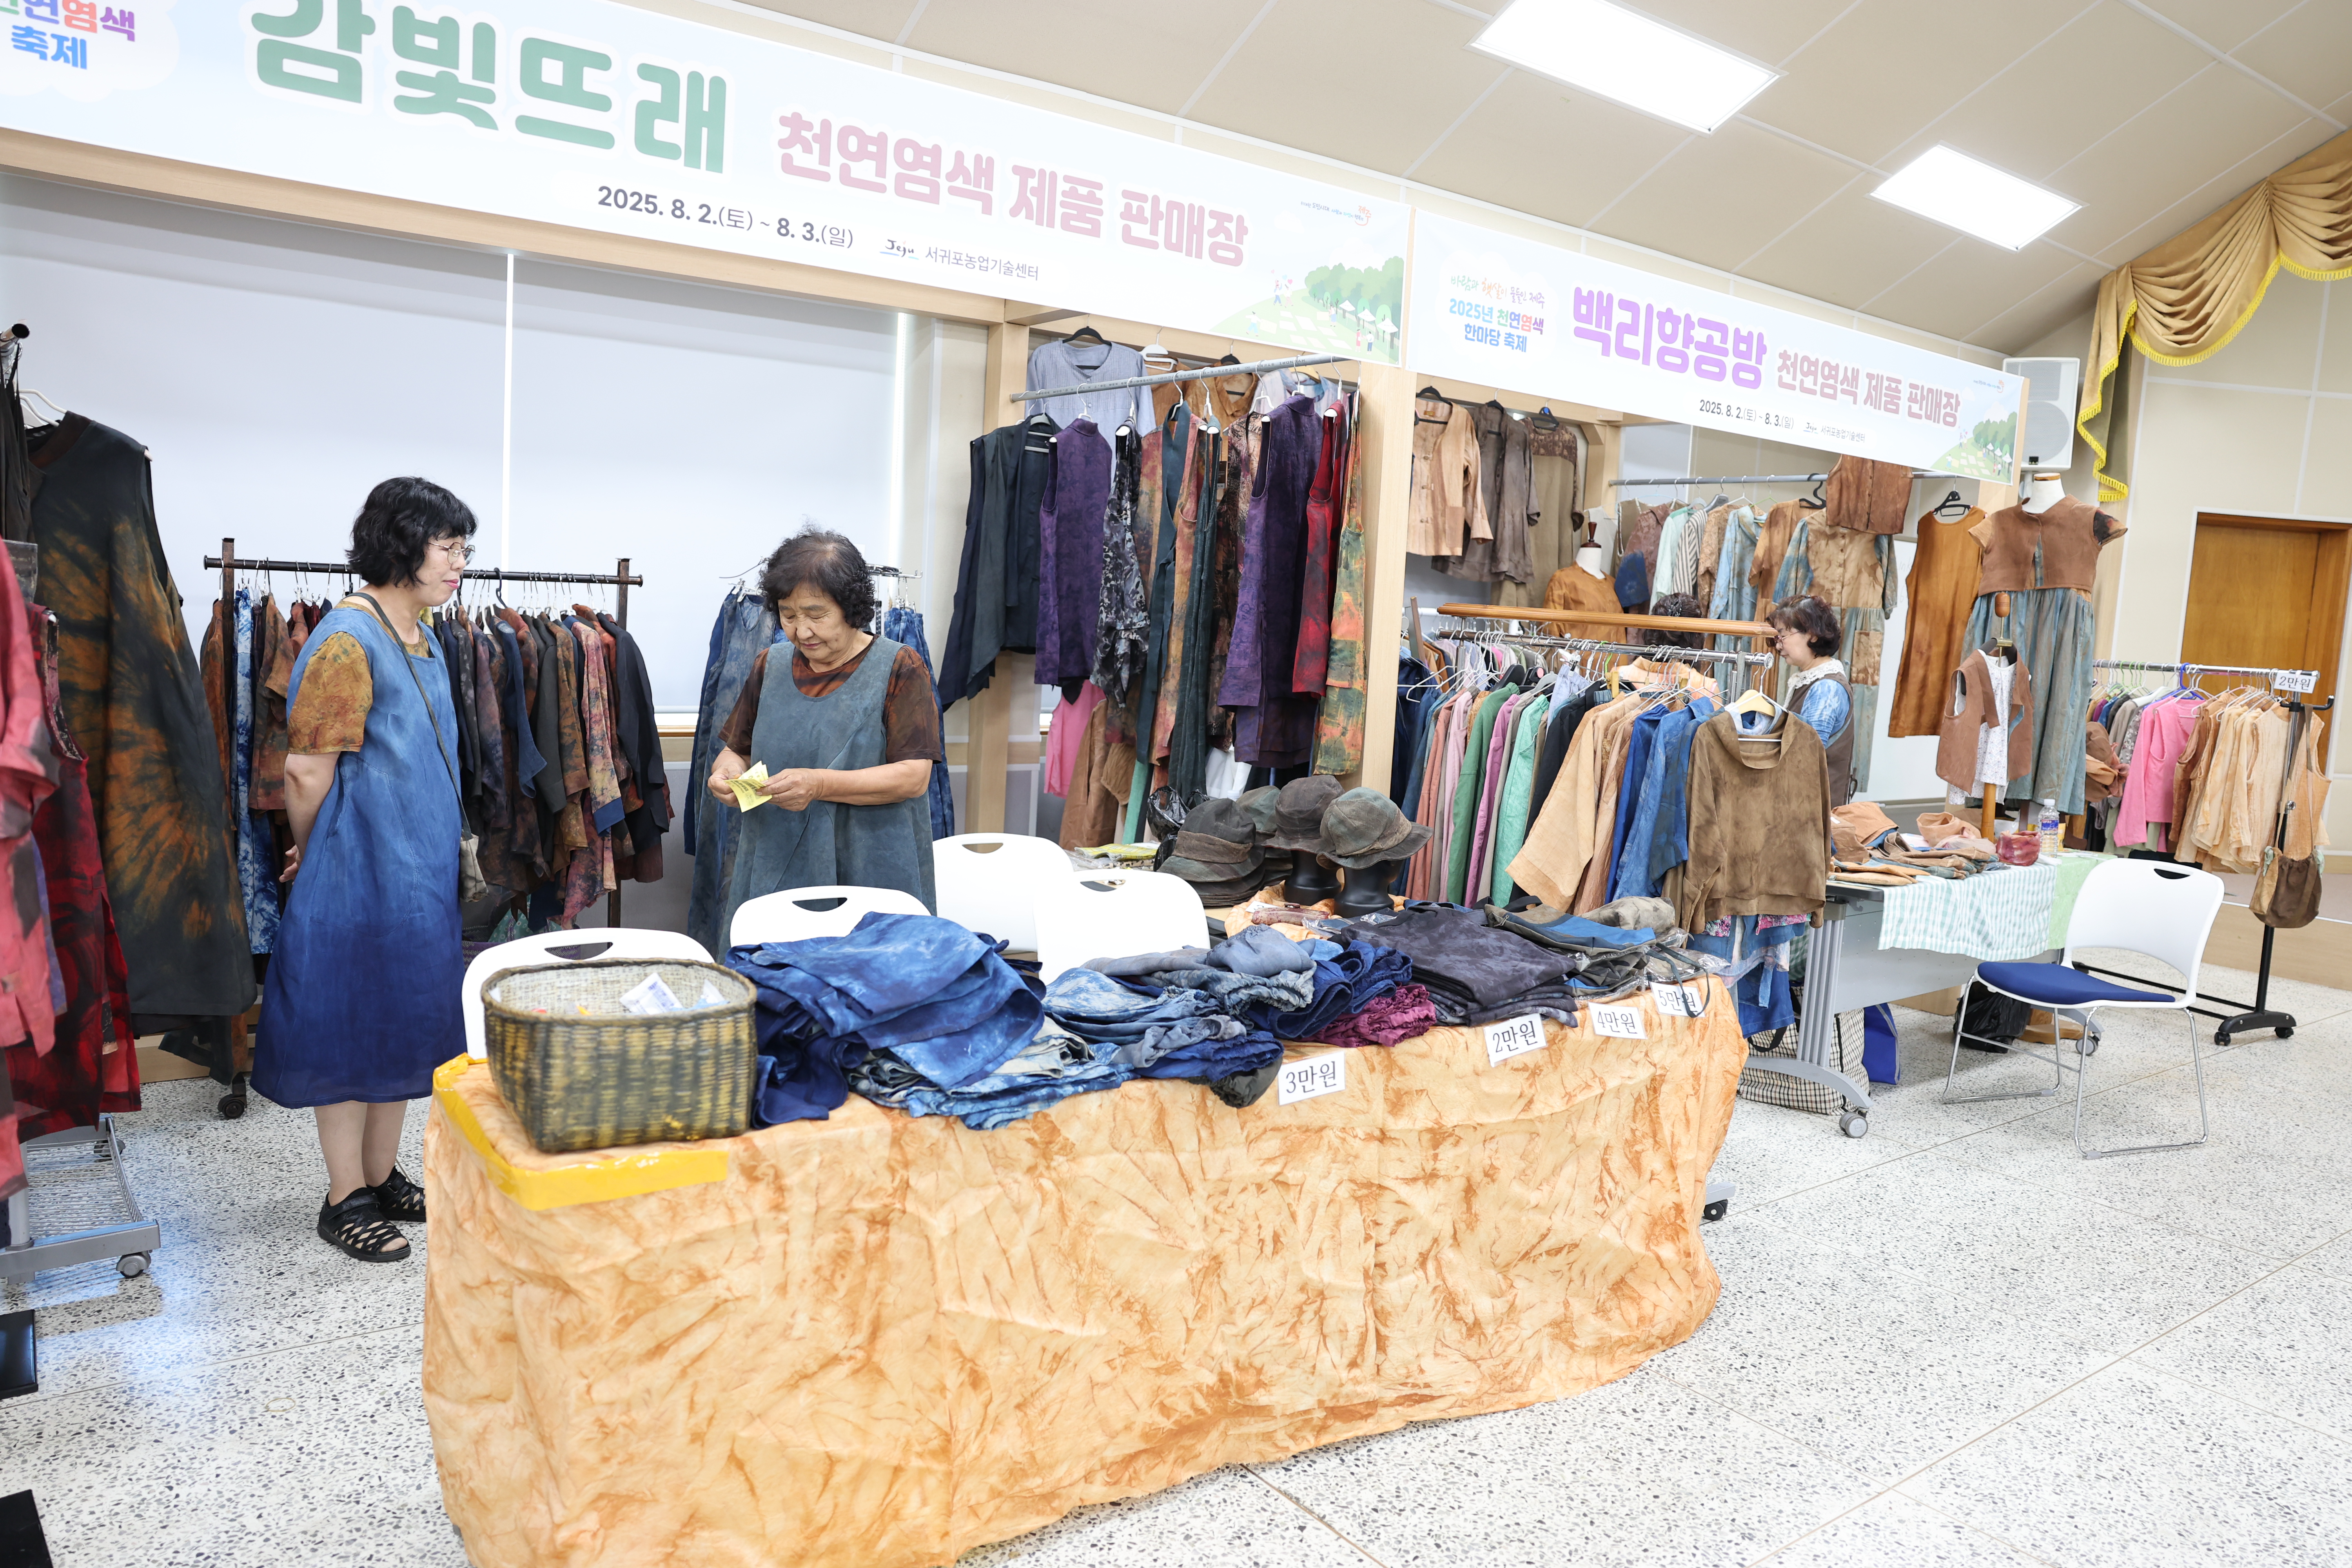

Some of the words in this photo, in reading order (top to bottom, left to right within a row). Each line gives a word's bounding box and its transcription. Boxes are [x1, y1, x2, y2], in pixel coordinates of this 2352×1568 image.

[0, 0, 135, 42] 연염색
[11, 25, 87, 70] 축제
[251, 0, 726, 174] 감빛뜨래
[778, 112, 994, 216] 천연염색
[1009, 165, 1103, 238] 제품
[1120, 189, 1248, 267] 판매장
[598, 186, 663, 215] 2025.
[1356, 205, 1372, 223] 제주
[885, 238, 914, 258] Jeju
[926, 247, 1038, 281] 서귀포농업기술센터
[1451, 276, 1479, 291] 바람과
[1482, 278, 1506, 299] 햇살이
[1510, 287, 1526, 304] 물들인
[1530, 292, 1544, 309] 제주
[1450, 298, 1493, 323] 2025년
[1497, 309, 1544, 335] 천연염색
[1465, 323, 1501, 347] 한마당
[1504, 332, 1527, 352] 축제
[1573, 287, 1767, 389] 백리향공방
[1778, 350, 1859, 405] 천연염색
[1864, 372, 1902, 414] 제품
[1907, 383, 1960, 428] 판매장
[1700, 399, 1723, 415] 2025.
[1821, 426, 1865, 442] 서귀포농업기술센터
[2279, 677, 2310, 690] 2만원
[1658, 990, 1698, 1013] 5만원
[1492, 1020, 1537, 1053] 2만원
[1597, 1011, 1635, 1036] 4만원
[1285, 1060, 1337, 1094] 3만원
